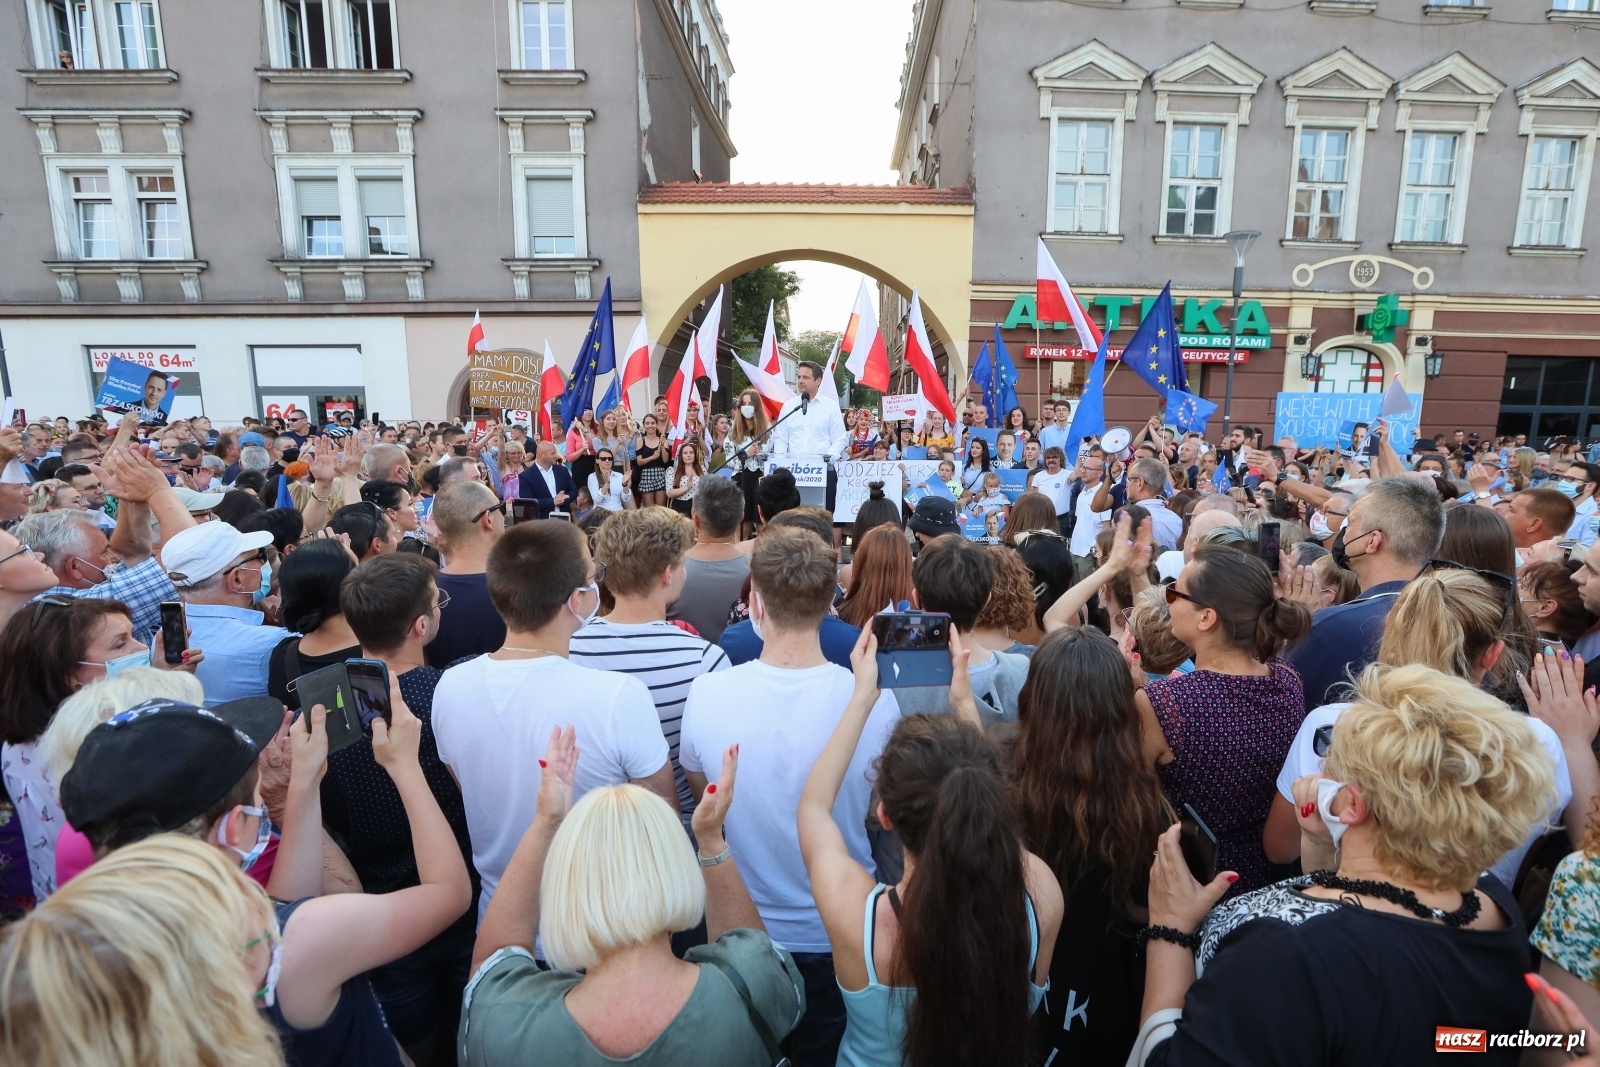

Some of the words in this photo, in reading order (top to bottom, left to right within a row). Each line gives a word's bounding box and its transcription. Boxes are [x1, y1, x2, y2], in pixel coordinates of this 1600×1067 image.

[1356, 268, 1374, 276] 1953
[1002, 294, 1271, 335] ATKA
[1179, 336, 1208, 345] POD
[1030, 347, 1067, 357] RYNEK
[1070, 348, 1083, 357] 12
[474, 355, 510, 368] MAMY
[101, 396, 164, 420] TRZASKOWSKI
[489, 396, 540, 410] PREZYDENT
[1278, 394, 1322, 418] WE'RE
[1324, 398, 1370, 420] WITH
[1278, 418, 1304, 437] YOU
[768, 462, 822, 474] Ribórz
